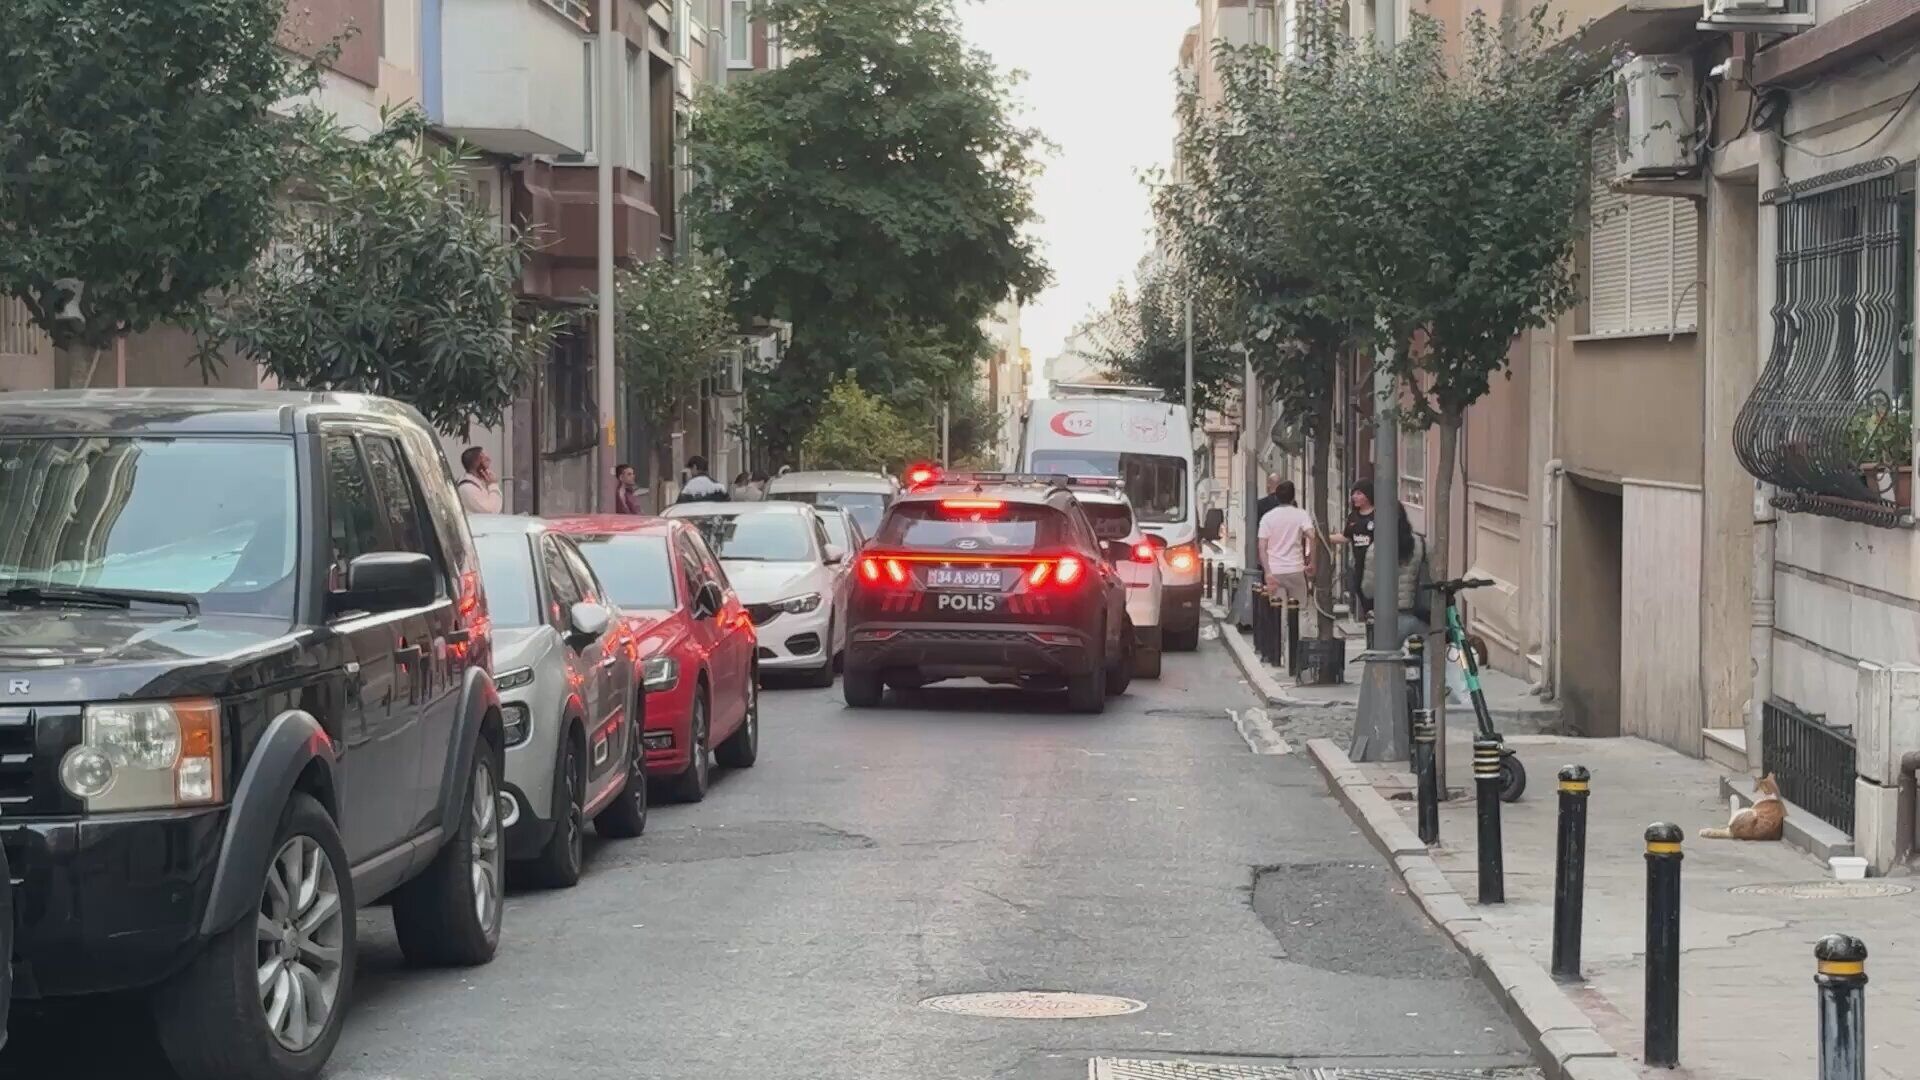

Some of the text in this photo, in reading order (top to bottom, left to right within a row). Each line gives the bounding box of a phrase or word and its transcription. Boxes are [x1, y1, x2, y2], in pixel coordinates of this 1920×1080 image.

[1069, 419, 1093, 428] 112
[938, 570, 951, 583] 34
[953, 571, 963, 584] A
[9, 679, 30, 693] R
